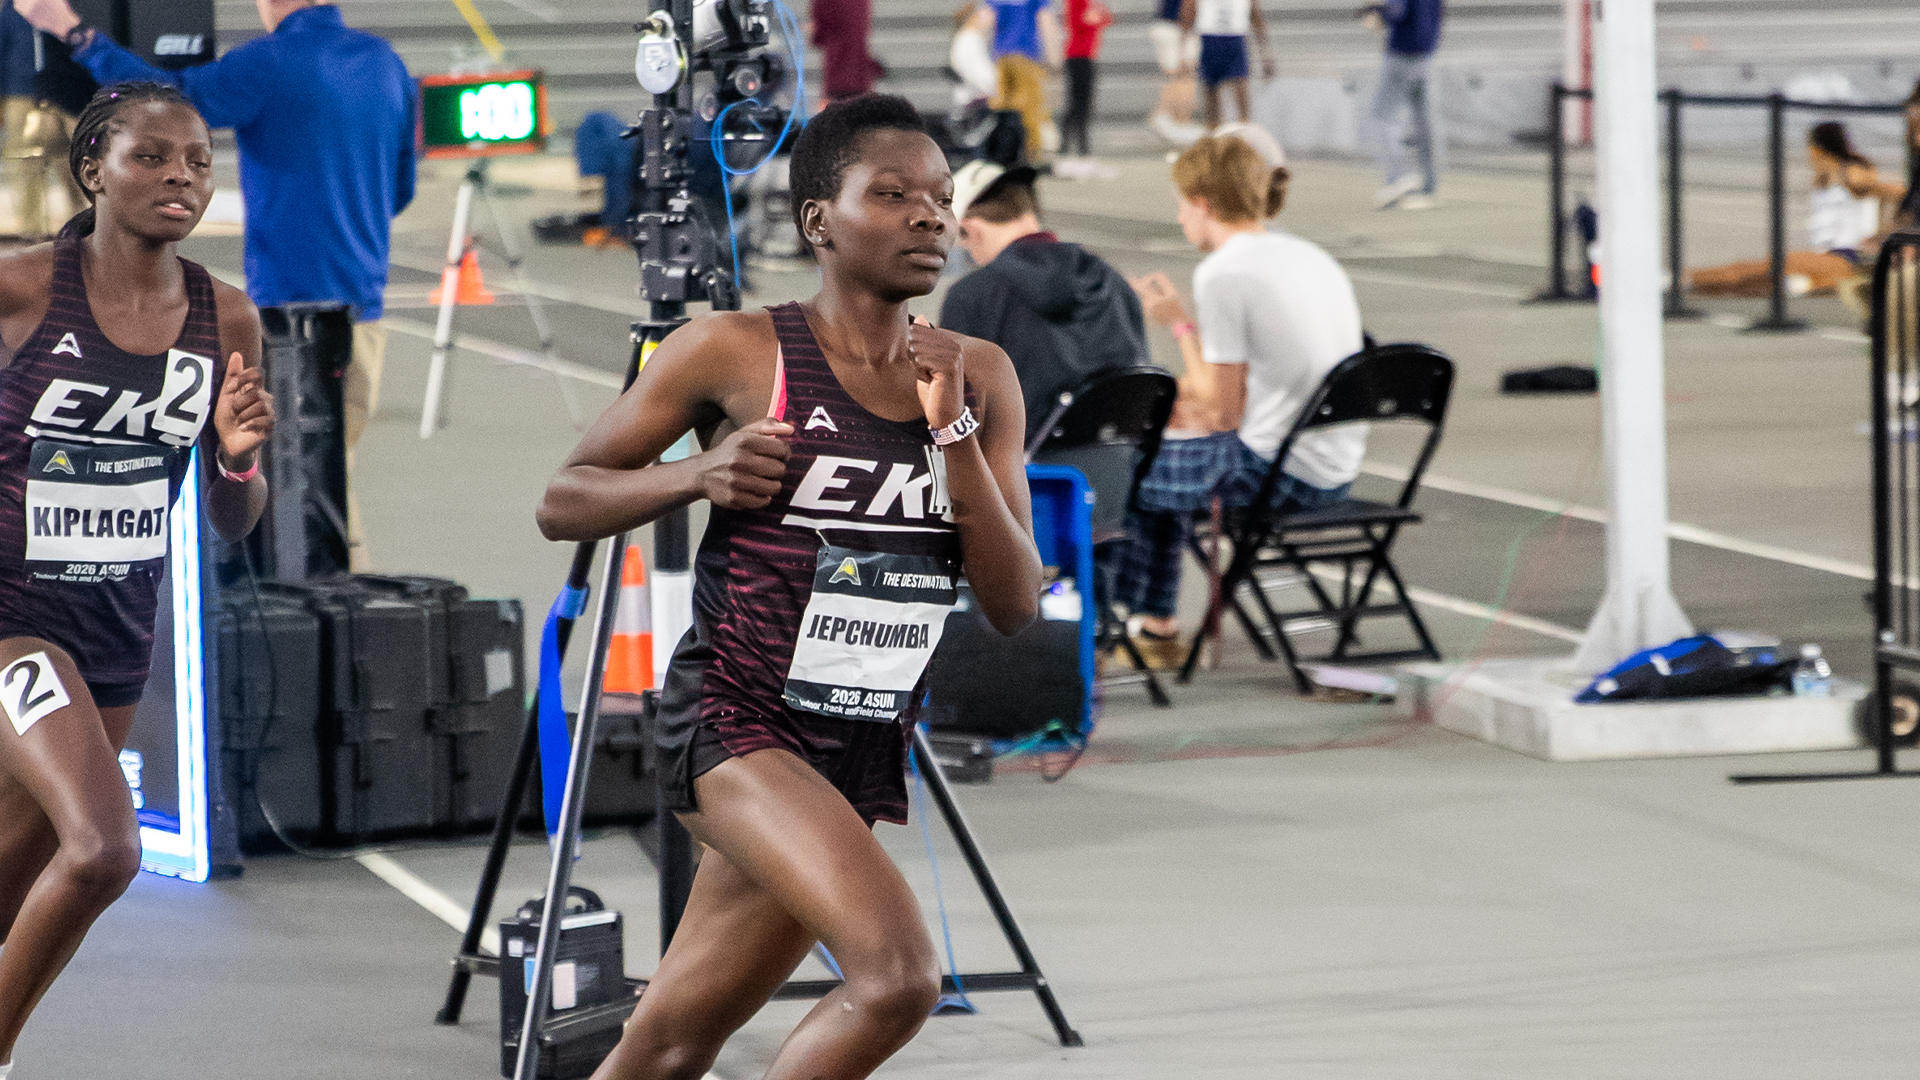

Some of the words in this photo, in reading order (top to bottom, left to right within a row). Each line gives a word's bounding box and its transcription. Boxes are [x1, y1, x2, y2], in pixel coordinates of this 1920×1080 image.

[164, 357, 204, 423] 2
[30, 378, 209, 446] EK
[95, 461, 113, 474] THE
[789, 455, 955, 523] EK
[33, 506, 165, 539] KIPLAGAT
[65, 563, 96, 575] 2026
[98, 563, 131, 576] ASUN
[882, 571, 901, 587] THE
[806, 614, 929, 649] JEPCHUMBA
[4, 660, 56, 719] 2
[830, 688, 862, 705] 2026
[863, 692, 896, 708] ASUN
[822, 703, 843, 714] Track
